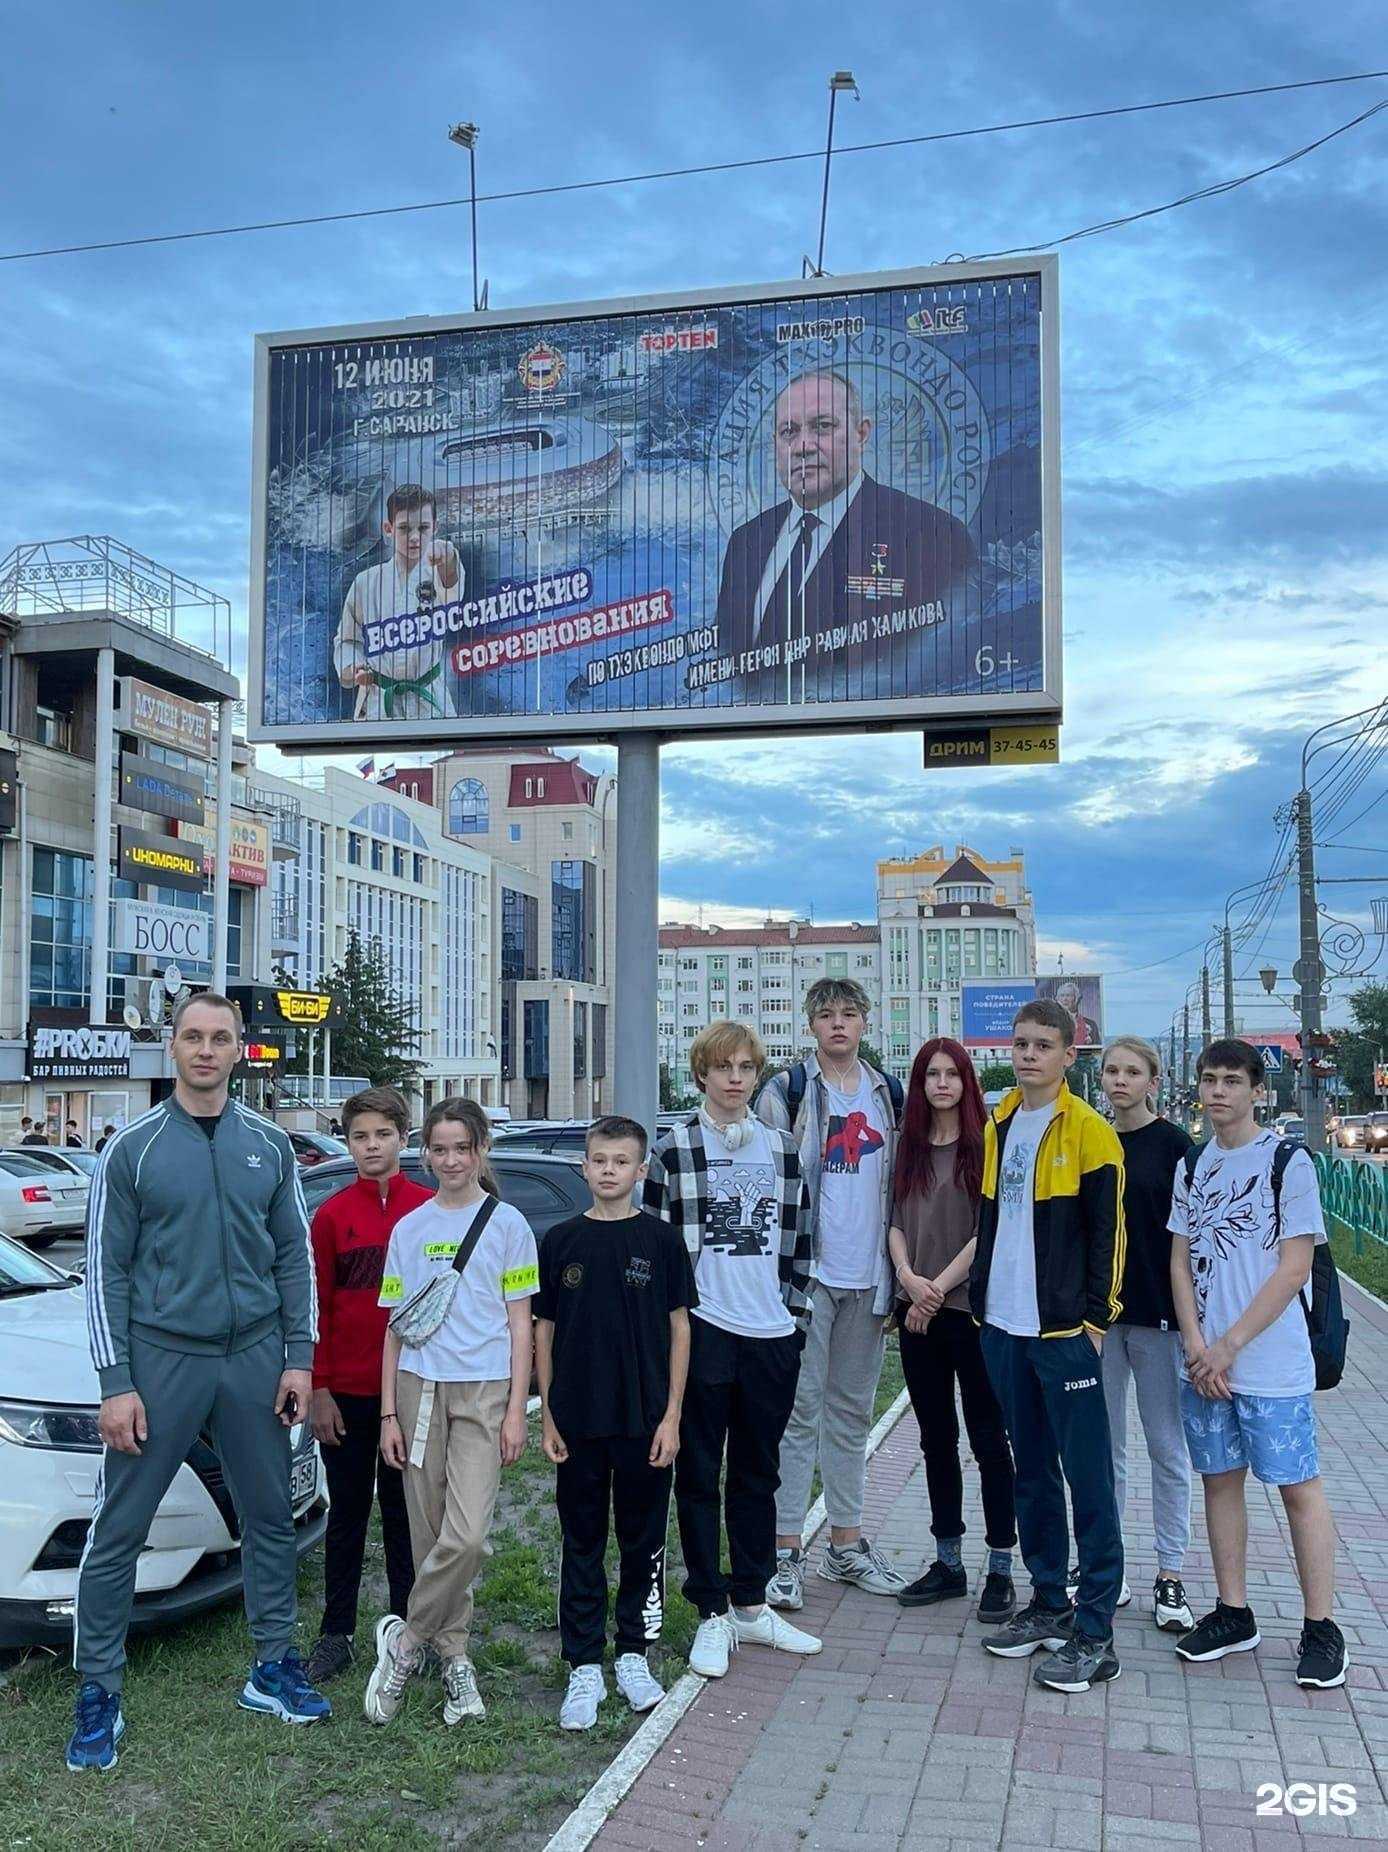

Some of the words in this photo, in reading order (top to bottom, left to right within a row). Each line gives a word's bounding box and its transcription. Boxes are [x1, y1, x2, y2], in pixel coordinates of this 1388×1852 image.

[335, 362, 359, 389] 12
[365, 356, 434, 387] ИЮНЯ
[372, 388, 433, 410] 2021
[721, 374, 771, 511] ЕРАЦИЯ
[947, 421, 982, 515] РОСС
[740, 643, 780, 674] ГЕРОЯ
[815, 619, 868, 654] РАВИЛЯ
[871, 600, 945, 639] ХАЛИКОВА
[588, 661, 604, 686] ПО
[975, 645, 1019, 676] 6+
[929, 741, 985, 757] ДРИМ
[993, 738, 1056, 753] 37-45-45
[229, 843, 265, 863] КТИВ
[135, 915, 200, 956] БОСС
[33, 1065, 50, 1076] БАР
[52, 1065, 87, 1076] ПИВНЫХ
[89, 1062, 128, 1076] РАДОСТЕЙ
[301, 1462, 312, 1484] 58
[641, 1581, 663, 1640] Nike
